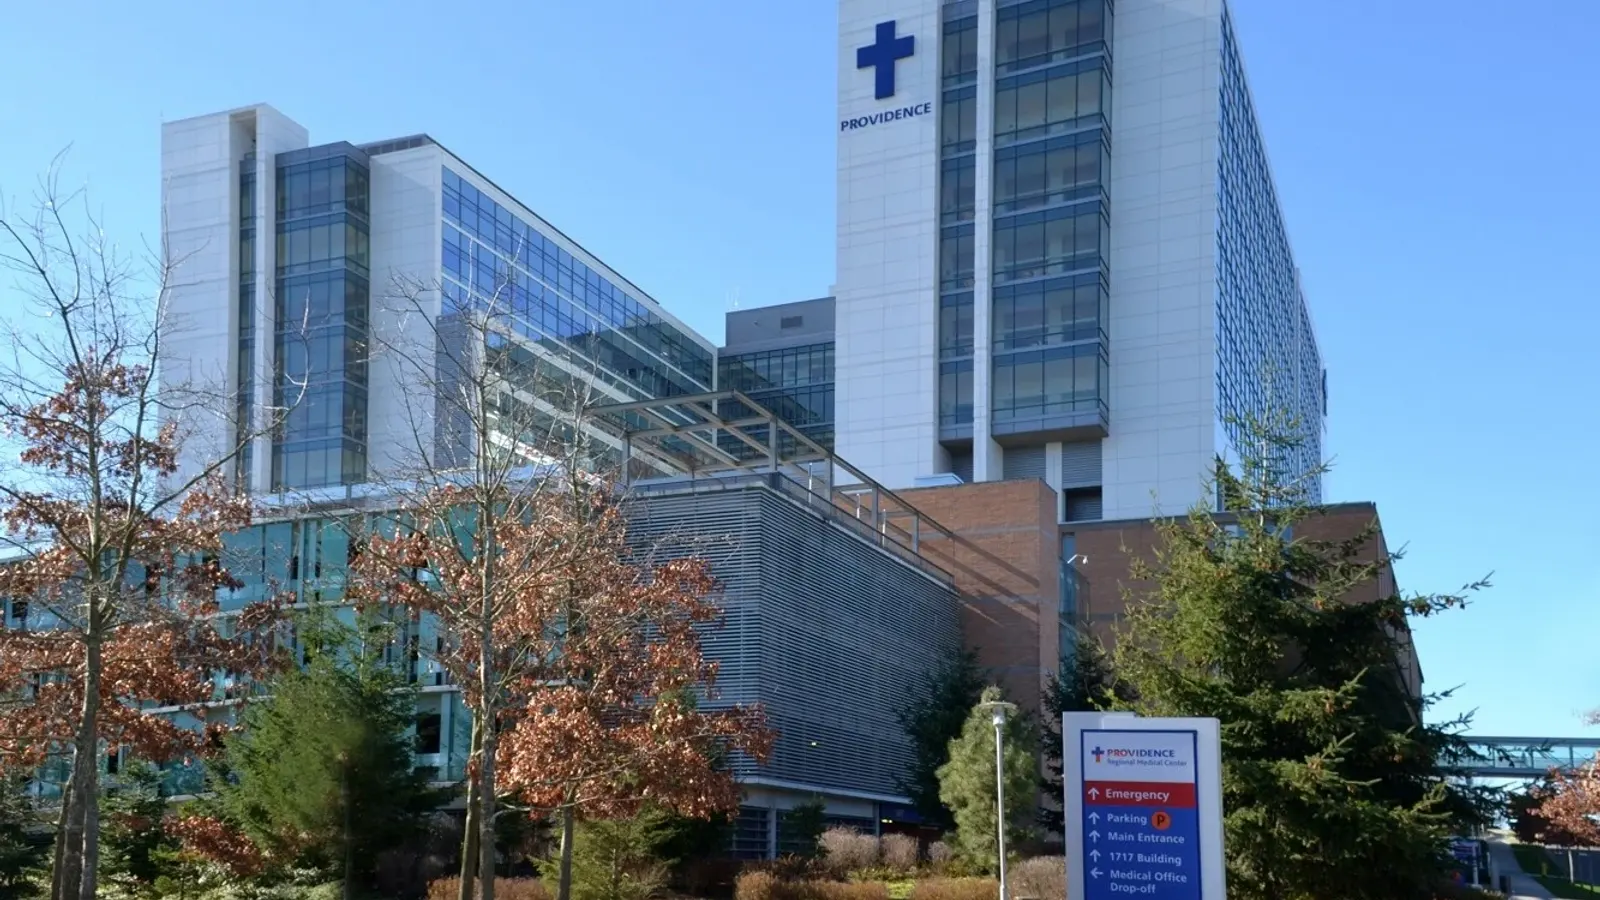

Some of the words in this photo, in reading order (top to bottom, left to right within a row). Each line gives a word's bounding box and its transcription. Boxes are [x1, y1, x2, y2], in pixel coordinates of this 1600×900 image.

[841, 102, 931, 131] PROVIDENCE
[1107, 748, 1175, 758] PROVIDENCE
[1107, 759, 1136, 767] Regional
[1137, 759, 1163, 767] Medical
[1164, 759, 1187, 767] Center
[1105, 788, 1170, 803] Emergency
[1107, 813, 1148, 826] Parking
[1156, 813, 1165, 825] P
[1108, 831, 1135, 842] Main
[1138, 832, 1185, 844] Entrance
[1110, 852, 1133, 862] 1717
[1137, 853, 1182, 867] Building
[1110, 869, 1151, 880] Medical
[1154, 871, 1188, 883] Office
[1110, 882, 1156, 894] Drop-off
